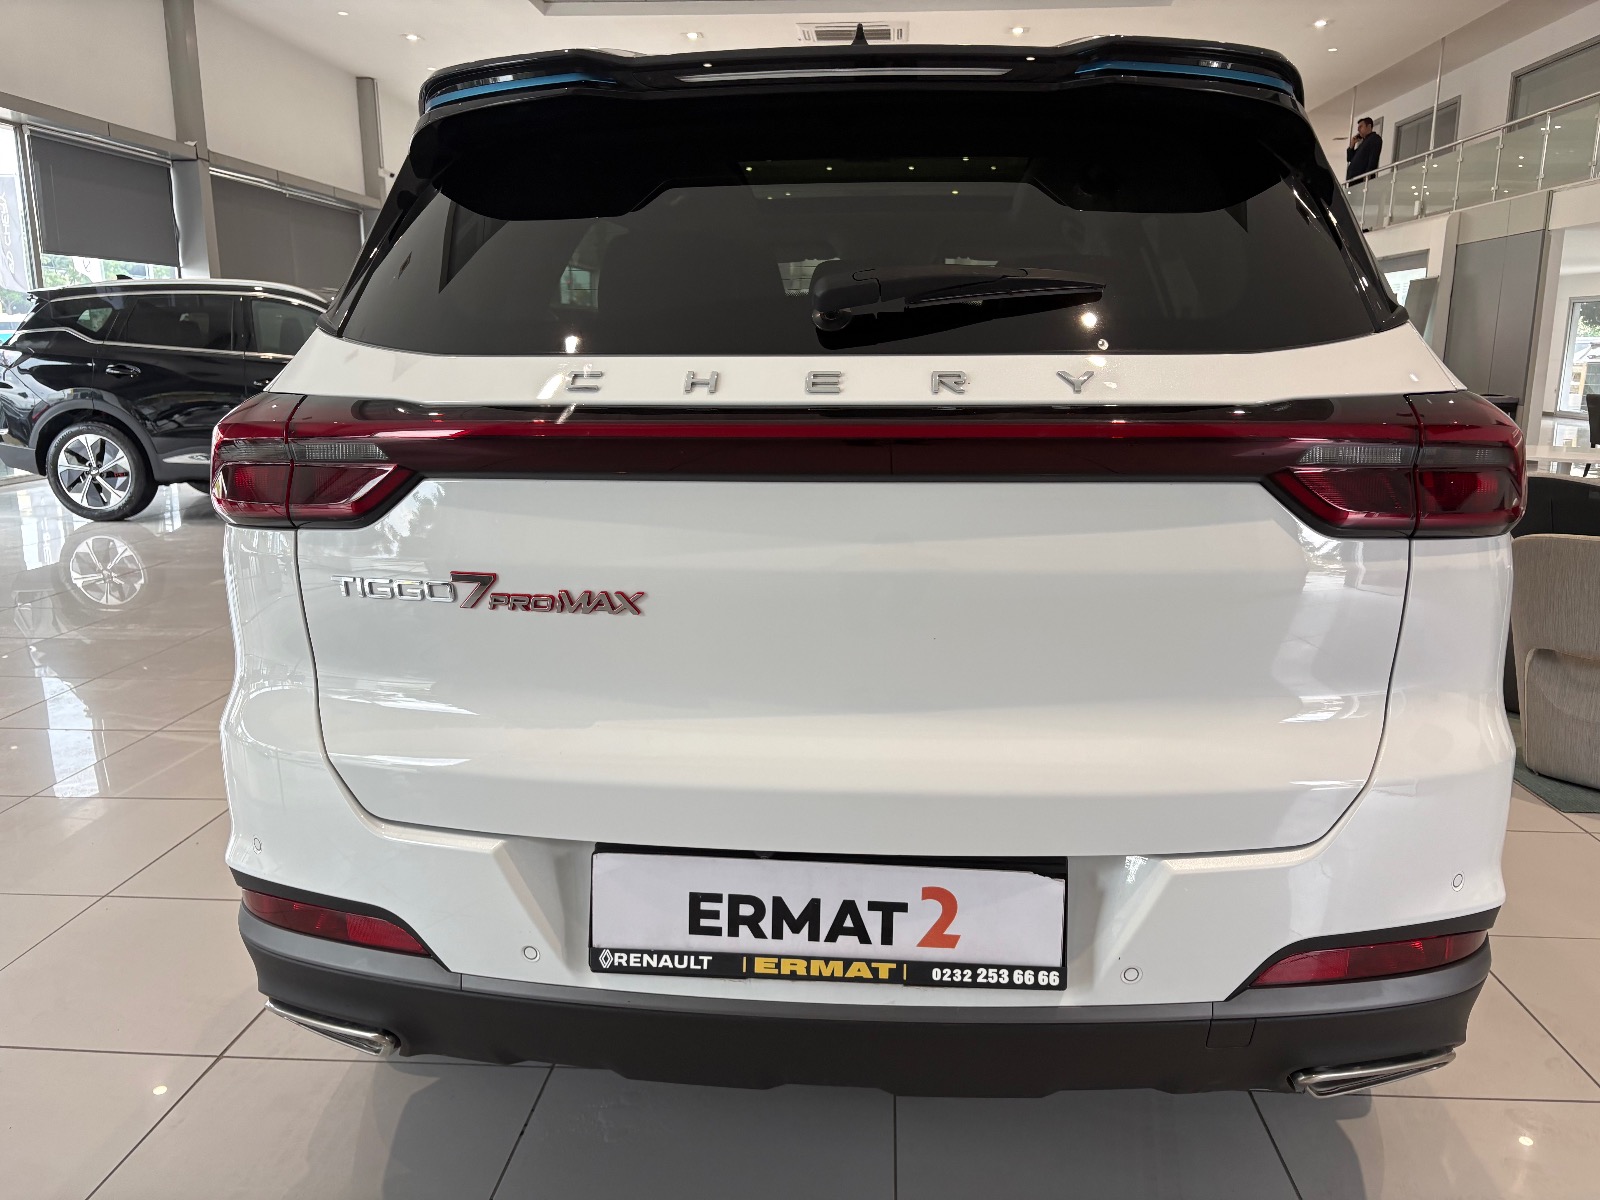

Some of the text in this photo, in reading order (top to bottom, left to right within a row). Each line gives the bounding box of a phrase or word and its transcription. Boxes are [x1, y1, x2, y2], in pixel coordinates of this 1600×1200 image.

[566, 370, 1095, 394] CHERY
[331, 574, 456, 602] TIGGO
[450, 570, 497, 609] 7
[688, 886, 961, 949] ERMAT 2
[614, 952, 1061, 986] RENAULT ERMAT 0232 253 66 66
